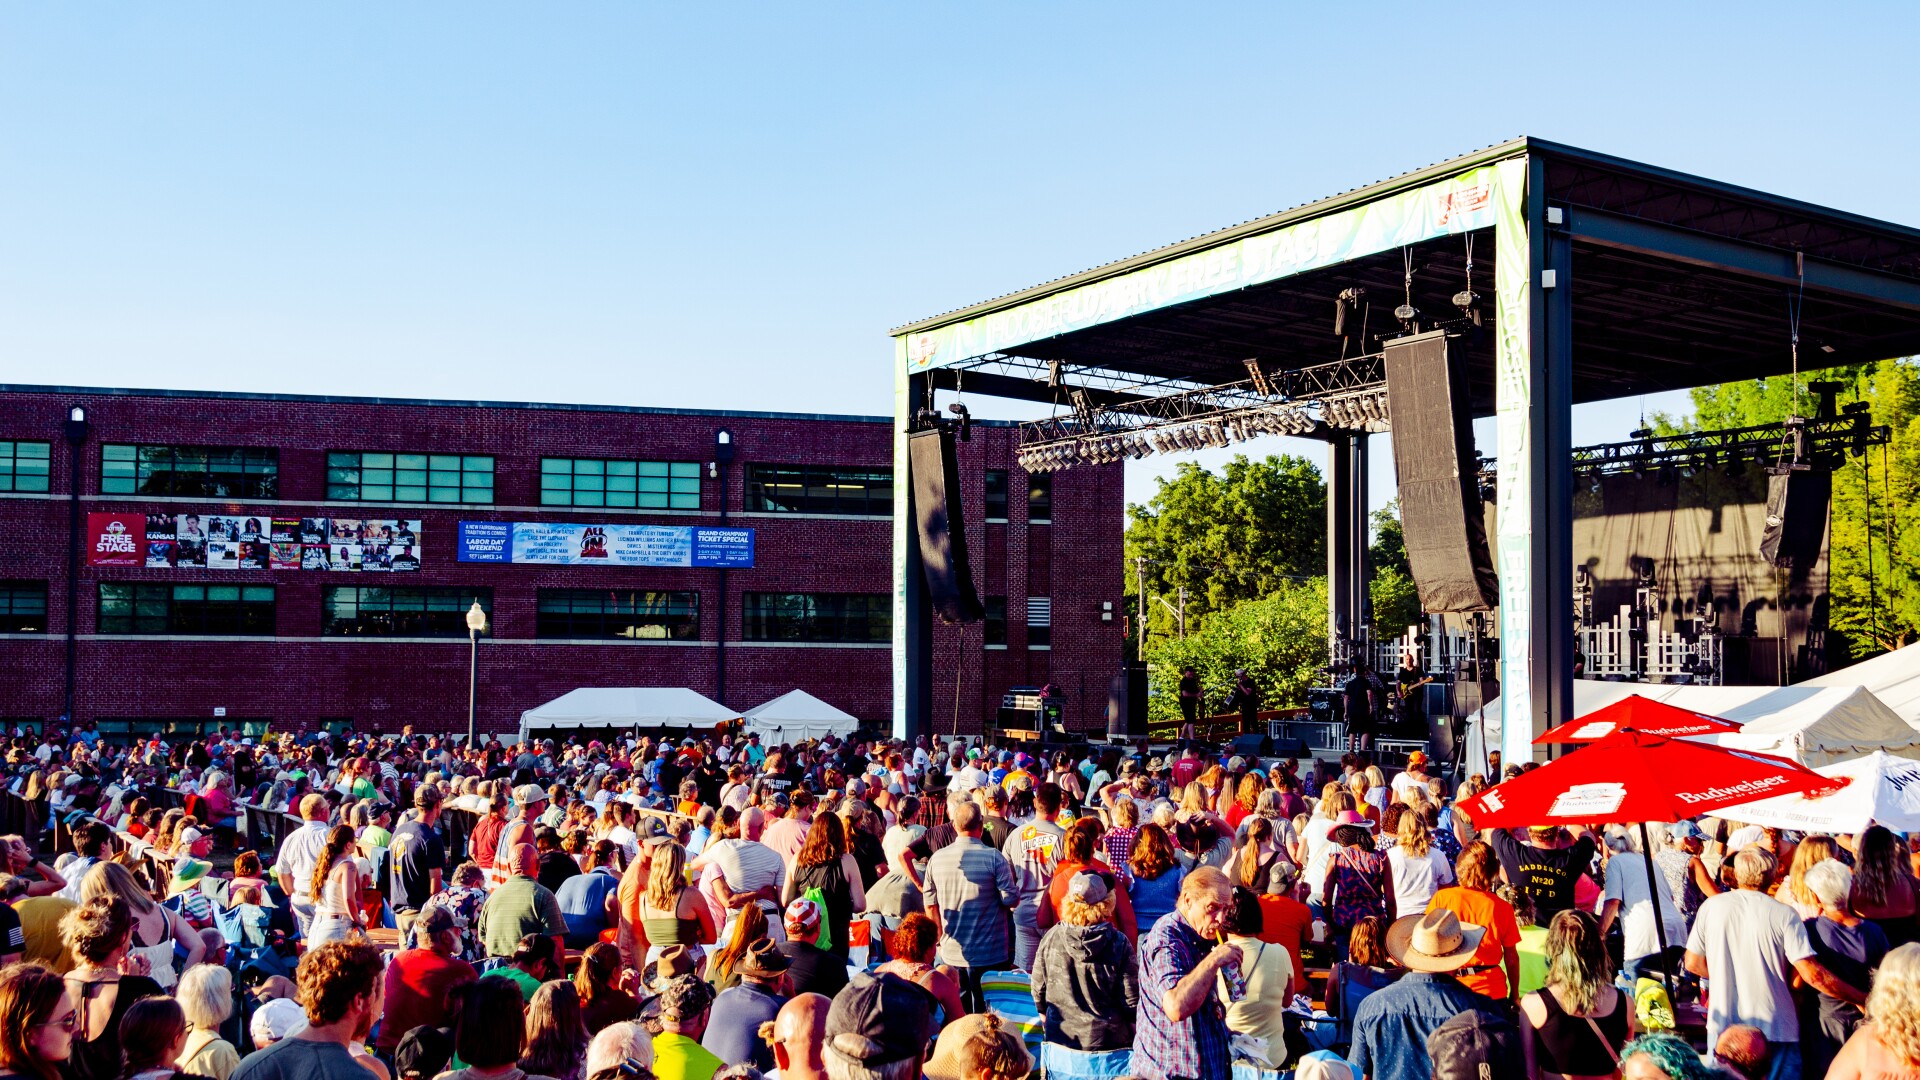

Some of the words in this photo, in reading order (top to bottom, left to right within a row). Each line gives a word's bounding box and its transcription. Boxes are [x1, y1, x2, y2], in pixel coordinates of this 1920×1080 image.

[989, 294, 1071, 343] HOOSIER
[1167, 246, 1237, 295] FREE
[1241, 214, 1341, 281] STAGE
[101, 534, 133, 544] FREE
[97, 543, 136, 553] STAGE
[1505, 549, 1528, 632] FREE
[1675, 775, 1791, 804] Budweiser
[1884, 774, 1914, 791] JIM
[1518, 863, 1554, 873] LADDER
